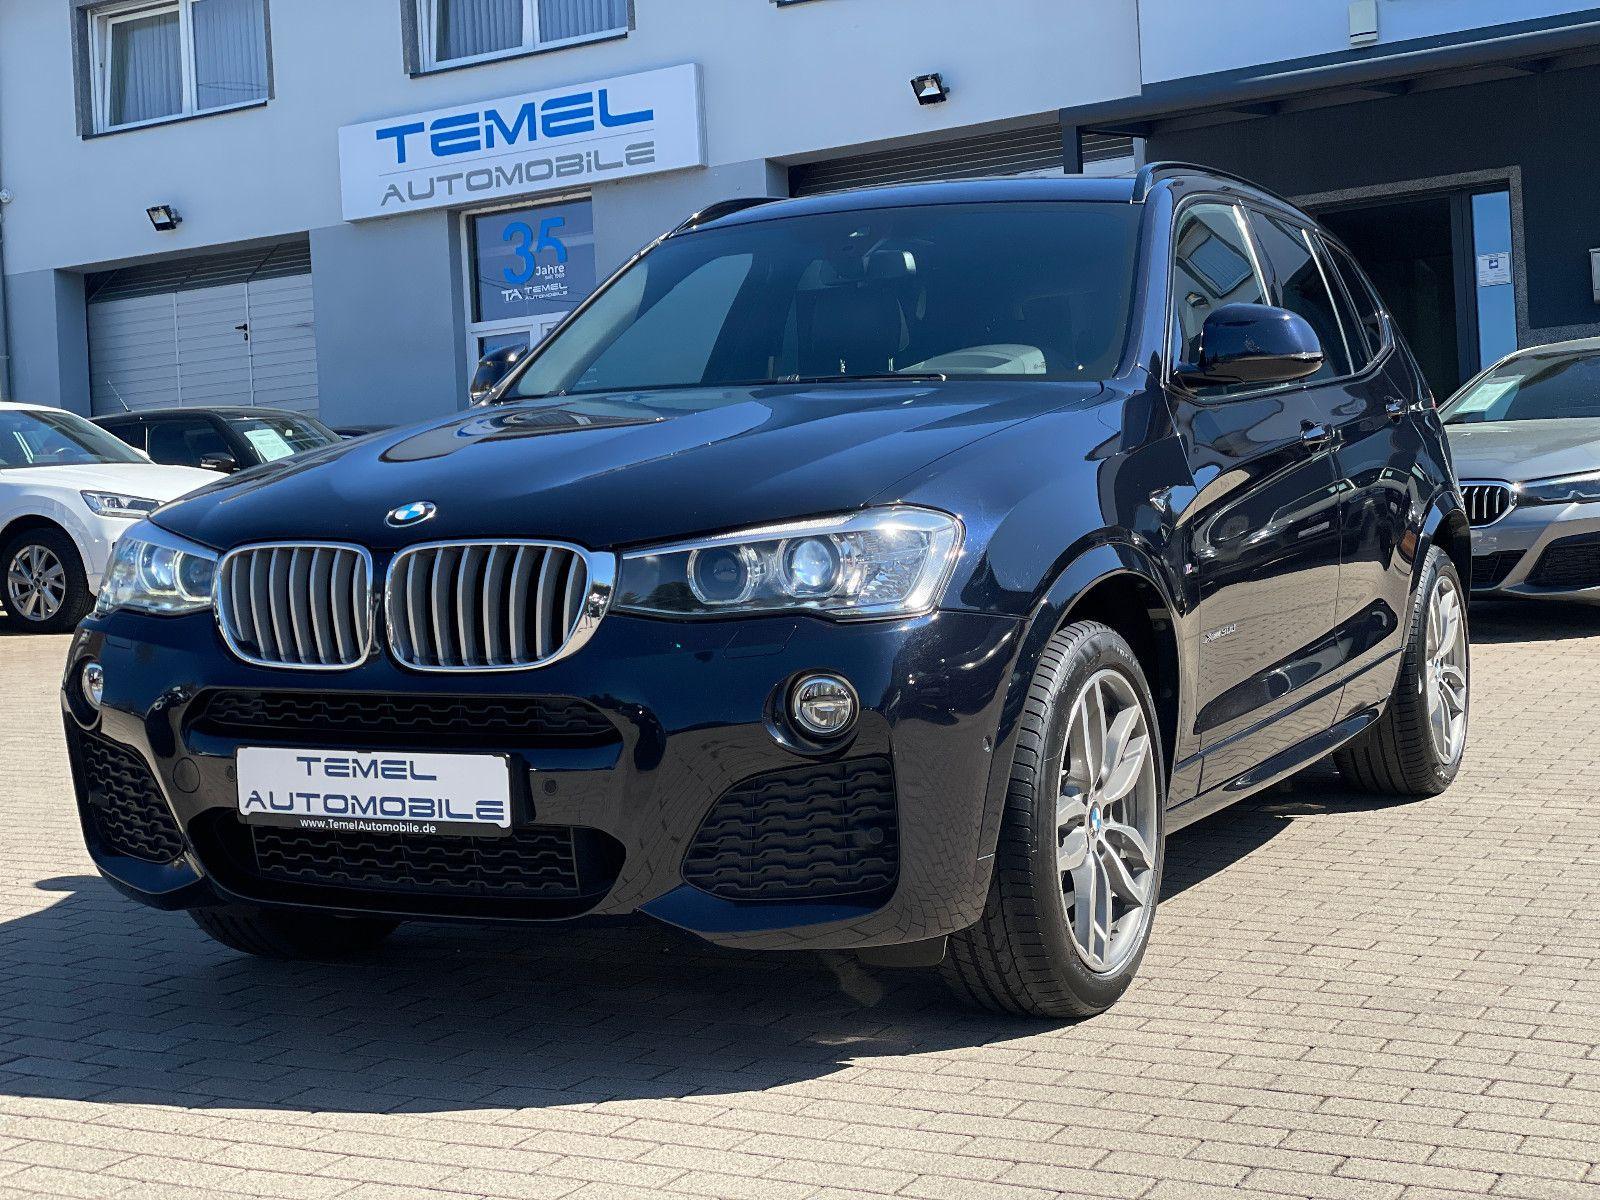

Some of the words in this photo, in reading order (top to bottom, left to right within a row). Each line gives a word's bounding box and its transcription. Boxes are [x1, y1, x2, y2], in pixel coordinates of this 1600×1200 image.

[376, 88, 654, 164] TEMEL
[502, 216, 568, 285] 35
[535, 264, 565, 276] Jahre
[501, 289, 523, 302] TA
[524, 282, 568, 294] TEMEL
[296, 755, 437, 781] TEMEL
[245, 789, 504, 821] AUTOMOBILE
[299, 818, 437, 834] www.TemelAutomobile.de
